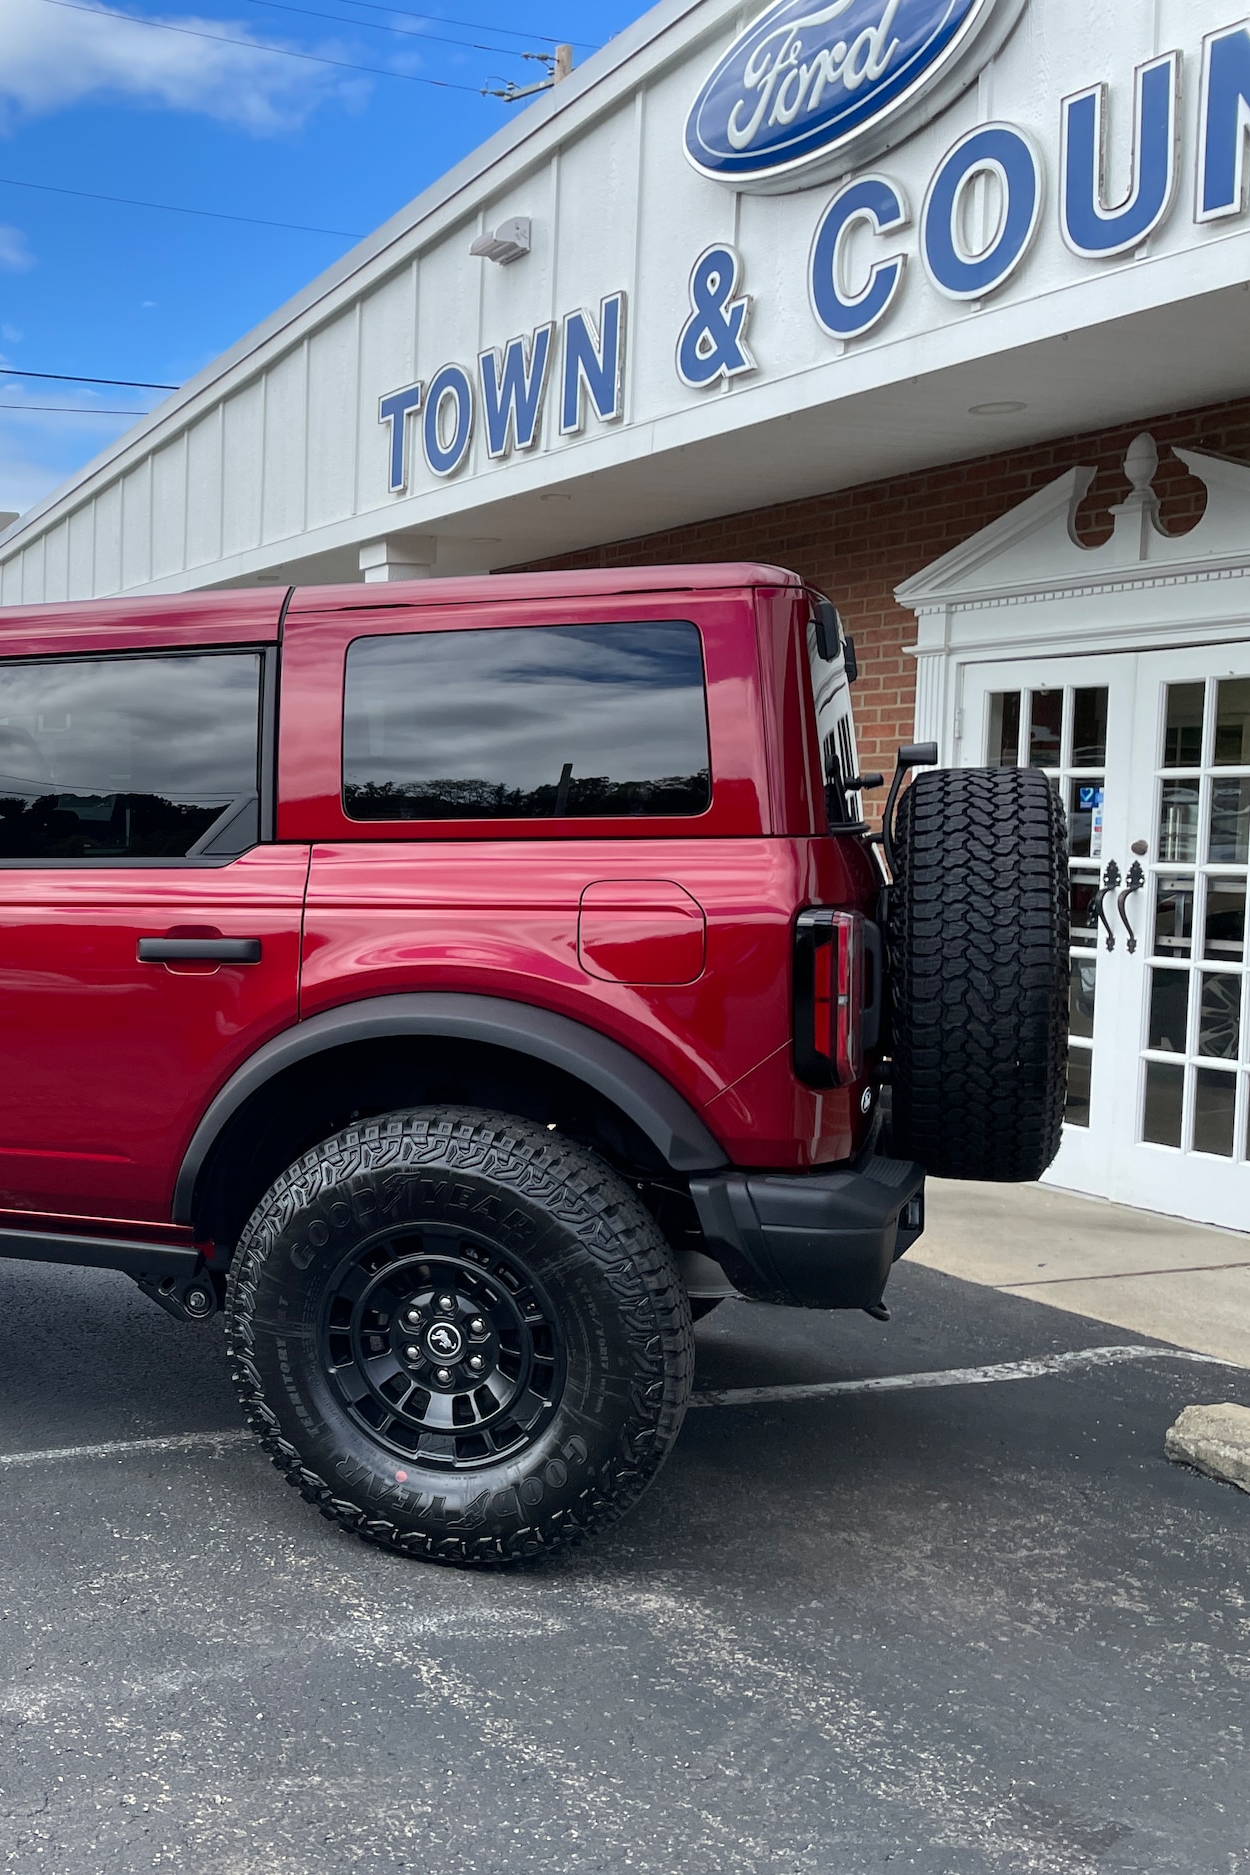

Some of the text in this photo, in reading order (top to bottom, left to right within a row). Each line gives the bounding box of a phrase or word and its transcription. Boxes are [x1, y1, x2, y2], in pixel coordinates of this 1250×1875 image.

[727, 0, 901, 150] Ford
[379, 290, 627, 494] TOWN
[676, 243, 758, 388] &
[290, 1171, 538, 1270] GOODYEAR
[336, 1435, 588, 1531] GOODYEAR
